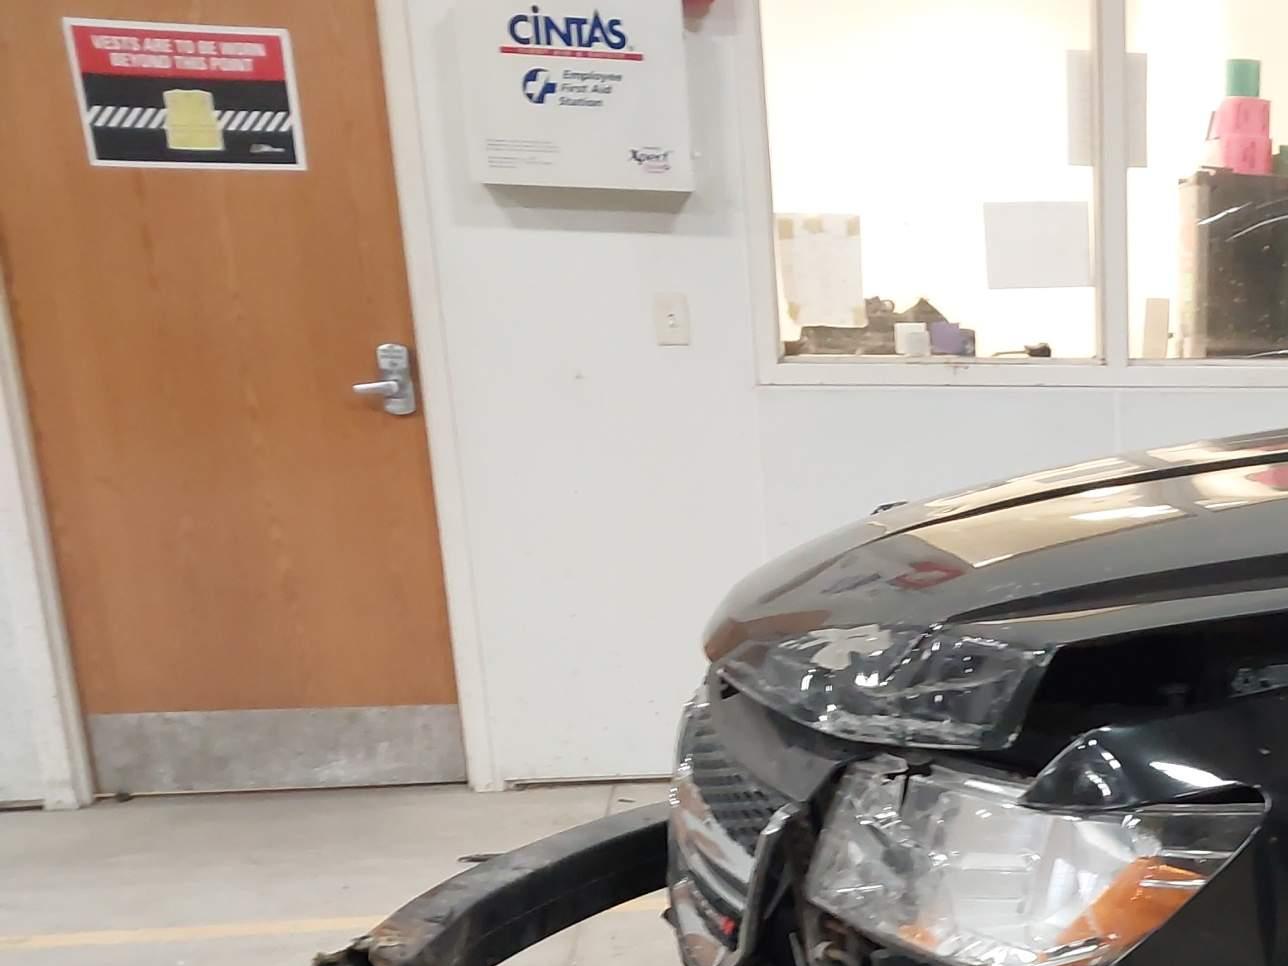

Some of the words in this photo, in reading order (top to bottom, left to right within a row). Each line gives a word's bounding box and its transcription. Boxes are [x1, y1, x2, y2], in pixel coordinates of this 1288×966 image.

[508, 5, 626, 50] CINTAS
[90, 34, 141, 51] VESTS
[143, 37, 173, 53] ARE
[174, 39, 195, 54] TO
[197, 40, 217, 55] BE
[174, 55, 208, 71] THIS
[563, 69, 623, 83] Employee
[560, 82, 588, 94] First
[591, 84, 613, 95] Aid
[558, 96, 604, 107] Station
